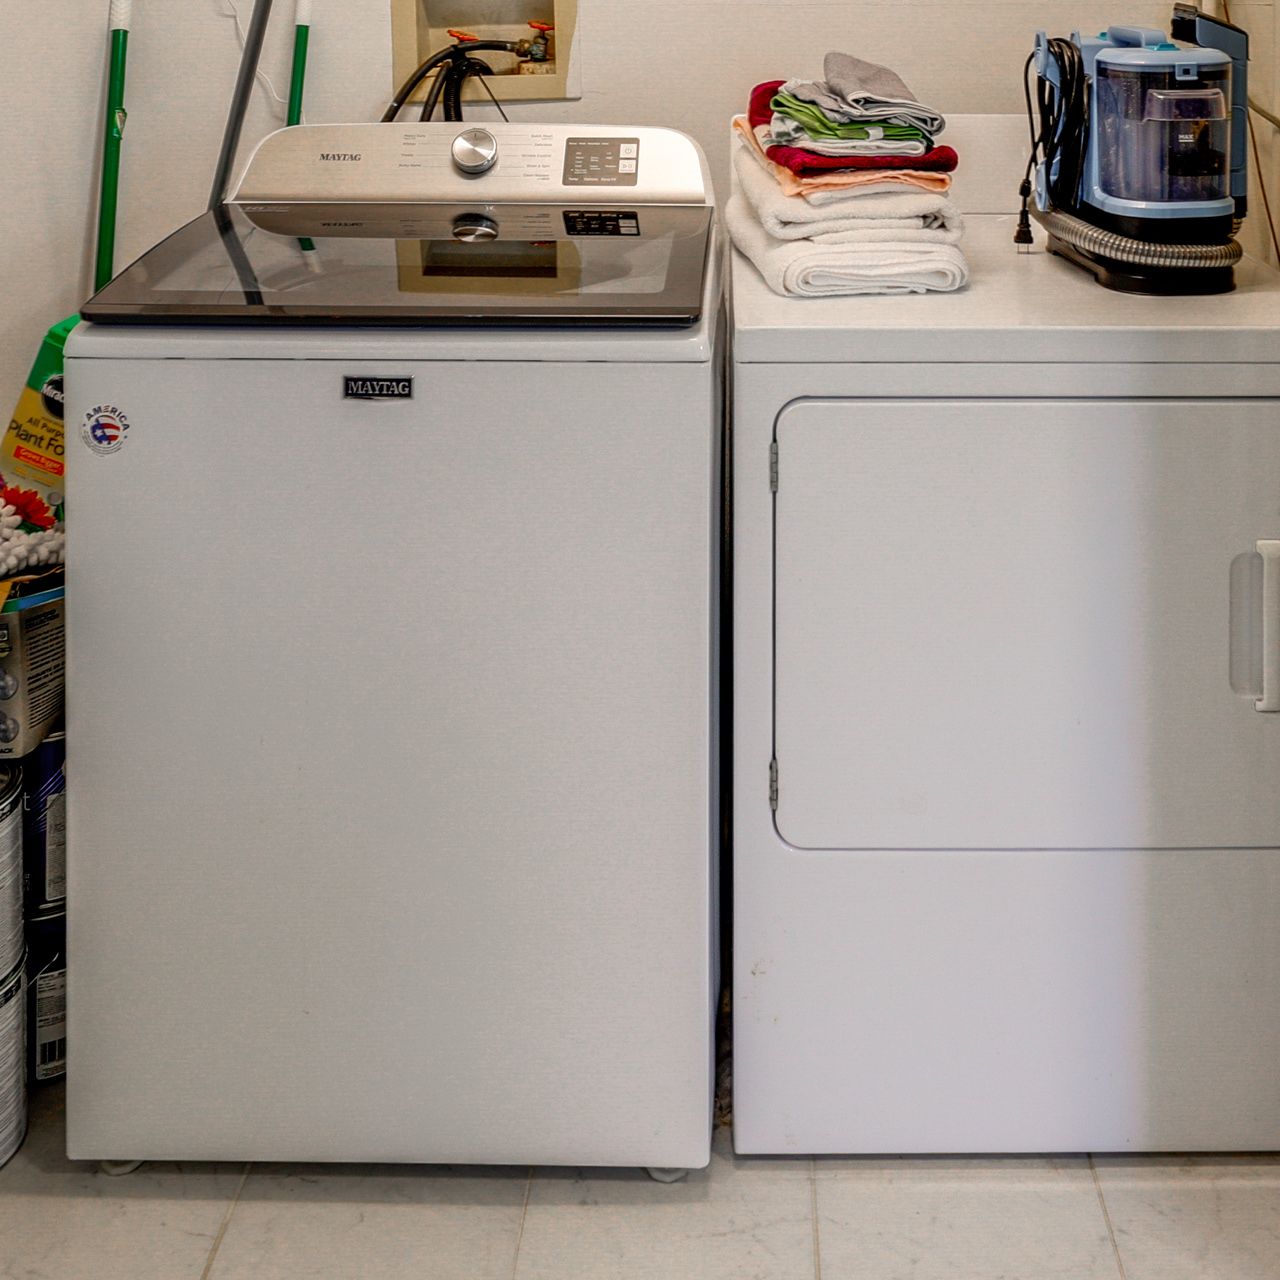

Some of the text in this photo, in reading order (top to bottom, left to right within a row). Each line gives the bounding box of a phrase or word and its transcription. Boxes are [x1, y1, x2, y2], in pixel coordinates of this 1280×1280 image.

[320, 153, 361, 161] MAYTAG
[347, 380, 410, 395] MAYTAG
[85, 404, 130, 432] AMERICA
[8, 419, 45, 450] Plant
